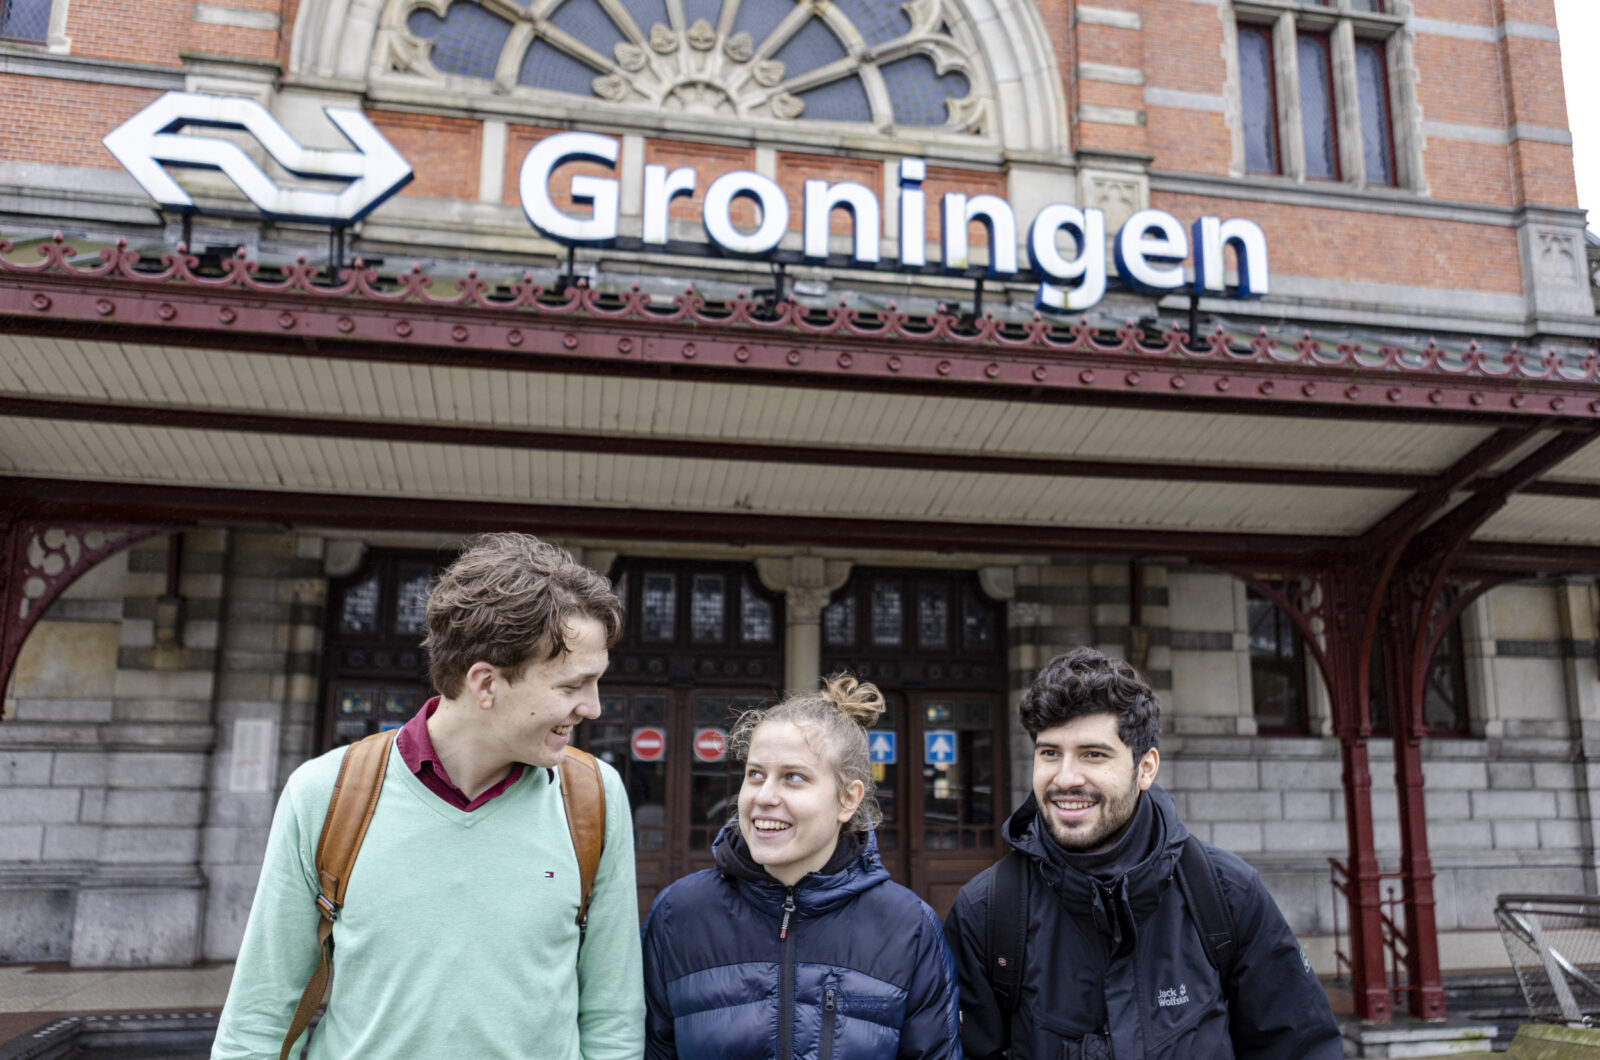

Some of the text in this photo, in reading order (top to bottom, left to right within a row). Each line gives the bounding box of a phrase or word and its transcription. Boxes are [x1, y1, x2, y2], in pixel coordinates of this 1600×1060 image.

[518, 131, 1270, 311] Groningen
[1157, 987, 1177, 998] Jack
[1158, 995, 1190, 1007] Wolfskin
